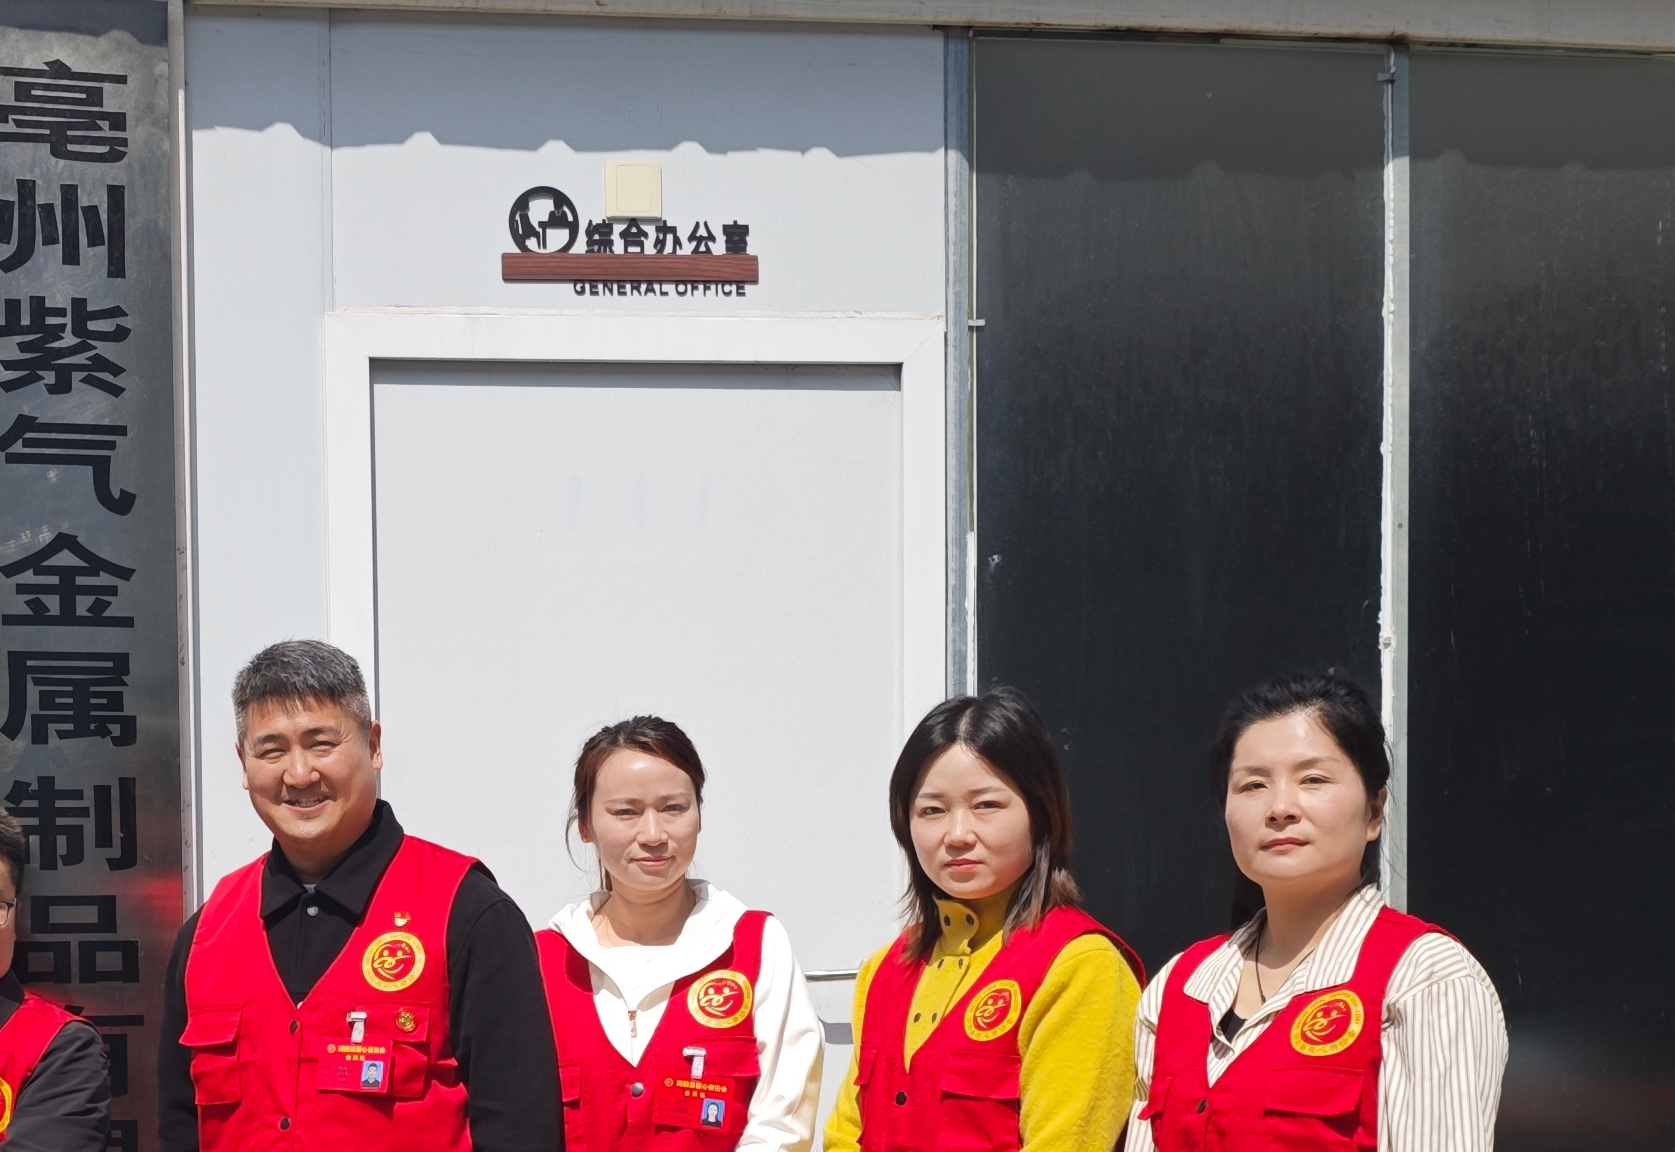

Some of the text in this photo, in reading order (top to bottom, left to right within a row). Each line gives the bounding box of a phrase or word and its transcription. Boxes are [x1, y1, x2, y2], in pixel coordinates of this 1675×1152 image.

[585, 218, 751, 255] 综合办公室
[573, 281, 747, 297] GENERAL OFFICE
